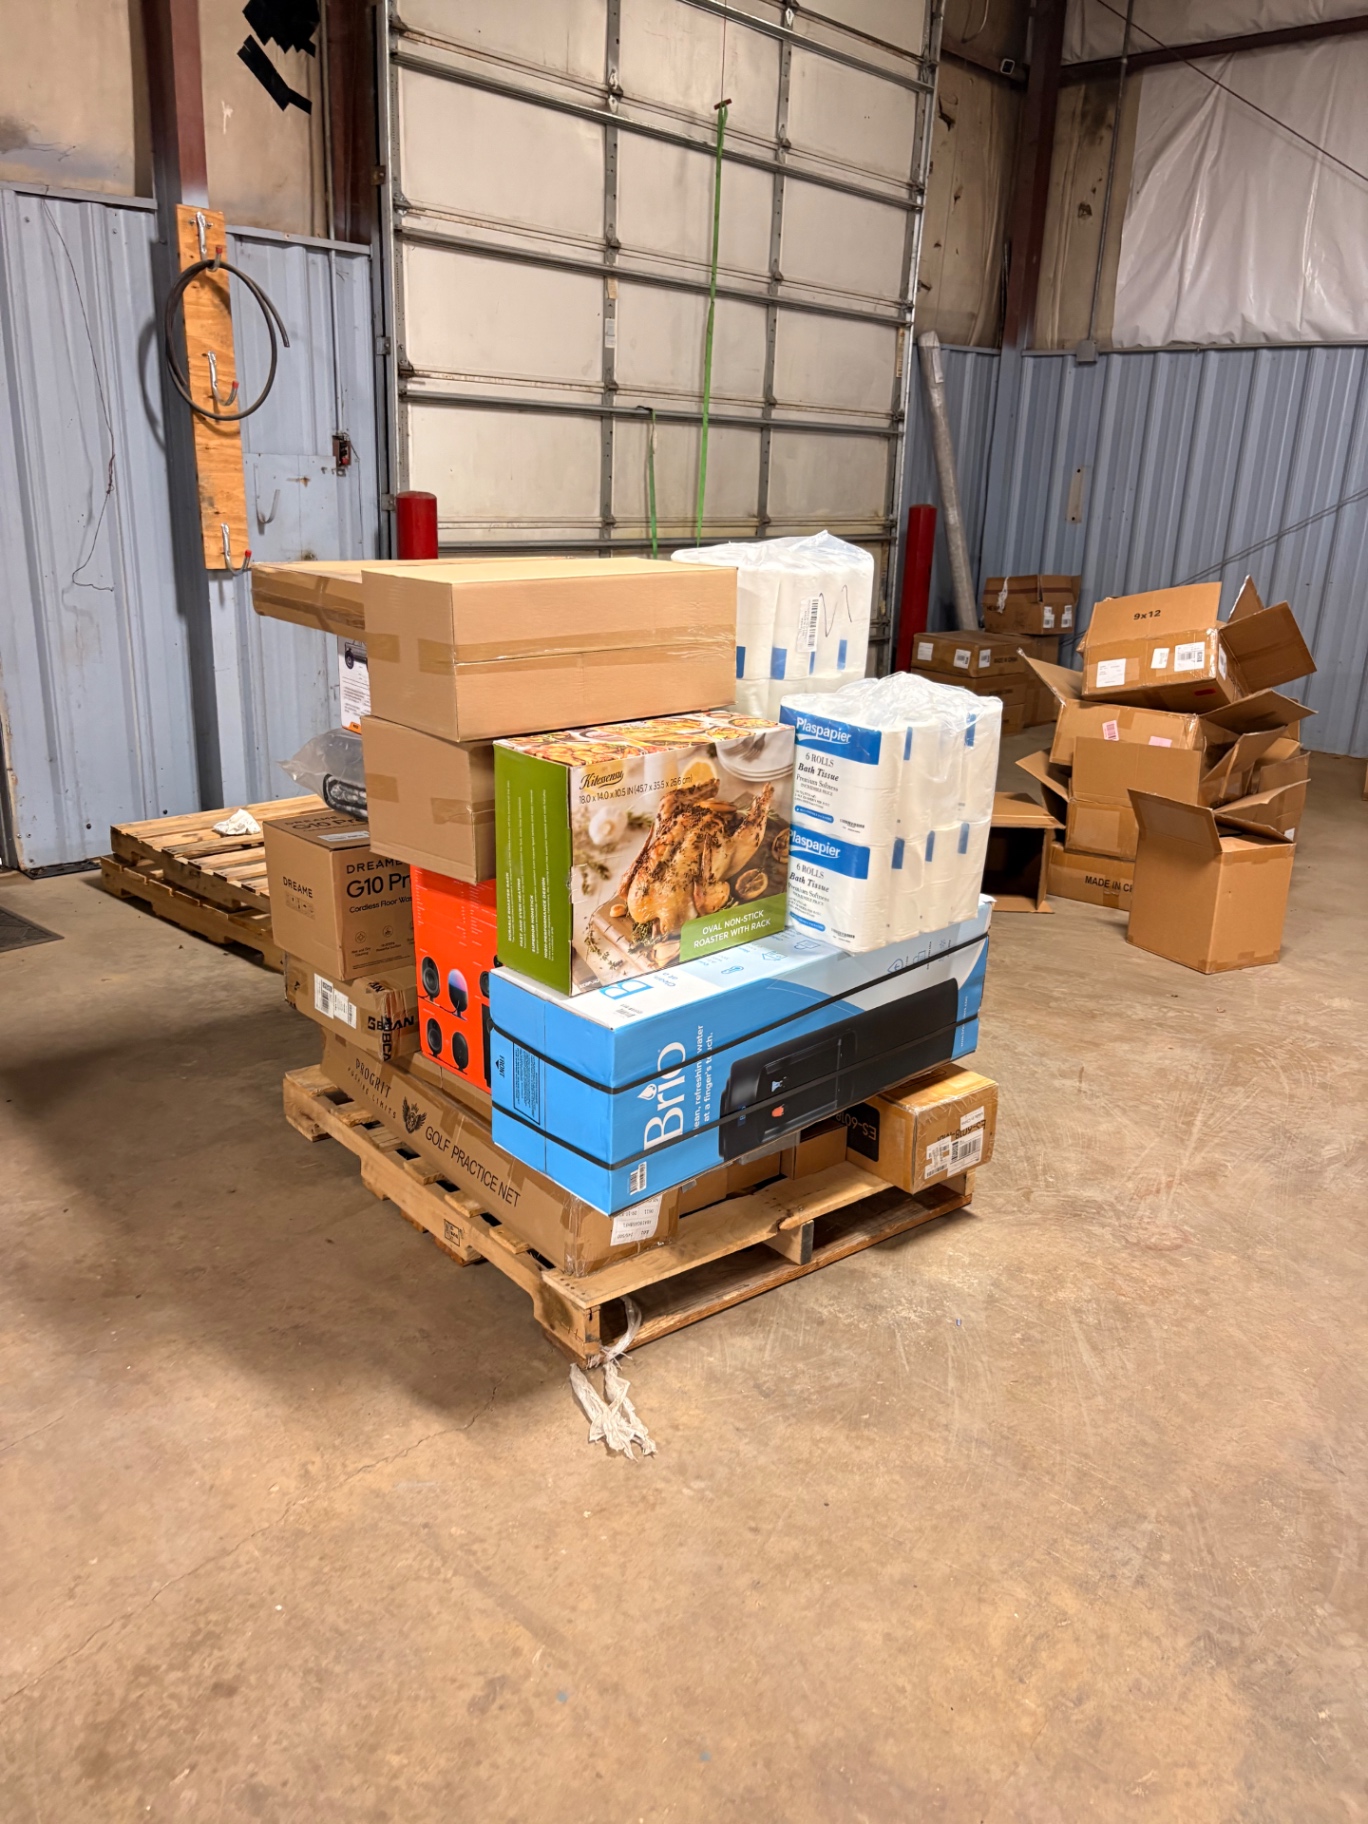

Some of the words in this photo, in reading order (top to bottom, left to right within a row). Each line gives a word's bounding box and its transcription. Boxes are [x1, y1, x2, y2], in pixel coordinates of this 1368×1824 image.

[1133, 609, 1162, 621] 9x12
[796, 717, 851, 741] Plaspapier
[797, 762, 815, 774] Bath
[817, 768, 839, 781] Tissue
[805, 752, 810, 760] 6
[811, 754, 834, 768] ROLLS
[346, 859, 403, 874] DREAME
[802, 864, 824, 879] ROLLS
[283, 876, 313, 898] DREAME
[346, 876, 384, 898] G10
[789, 872, 805, 884] Bath
[808, 879, 829, 892] Tissue
[1085, 876, 1110, 888] MADE
[1112, 881, 1121, 890] IN
[349, 902, 380, 914] Cordless
[380, 898, 398, 908] Floor
[693, 932, 729, 949] ROASTER
[730, 927, 749, 940] WITH
[751, 918, 771, 935] RACK
[702, 921, 722, 935] OVAL
[725, 909, 764, 930] NON-STICK
[696, 1025, 704, 1053] water
[355, 1058, 391, 1098] PROGRIT
[694, 1059, 703, 1104] refreshin
[703, 1066, 713, 1102] finger's
[348, 1067, 369, 1094] PUSHING
[372, 1093, 397, 1119] LIMITS
[642, 1041, 686, 1150] Brio
[693, 1106, 701, 1137] lean,
[703, 1111, 710, 1122] at
[425, 1126, 450, 1151] GOLF
[451, 1146, 498, 1192] PRACTICE
[498, 1184, 521, 1208] NET
